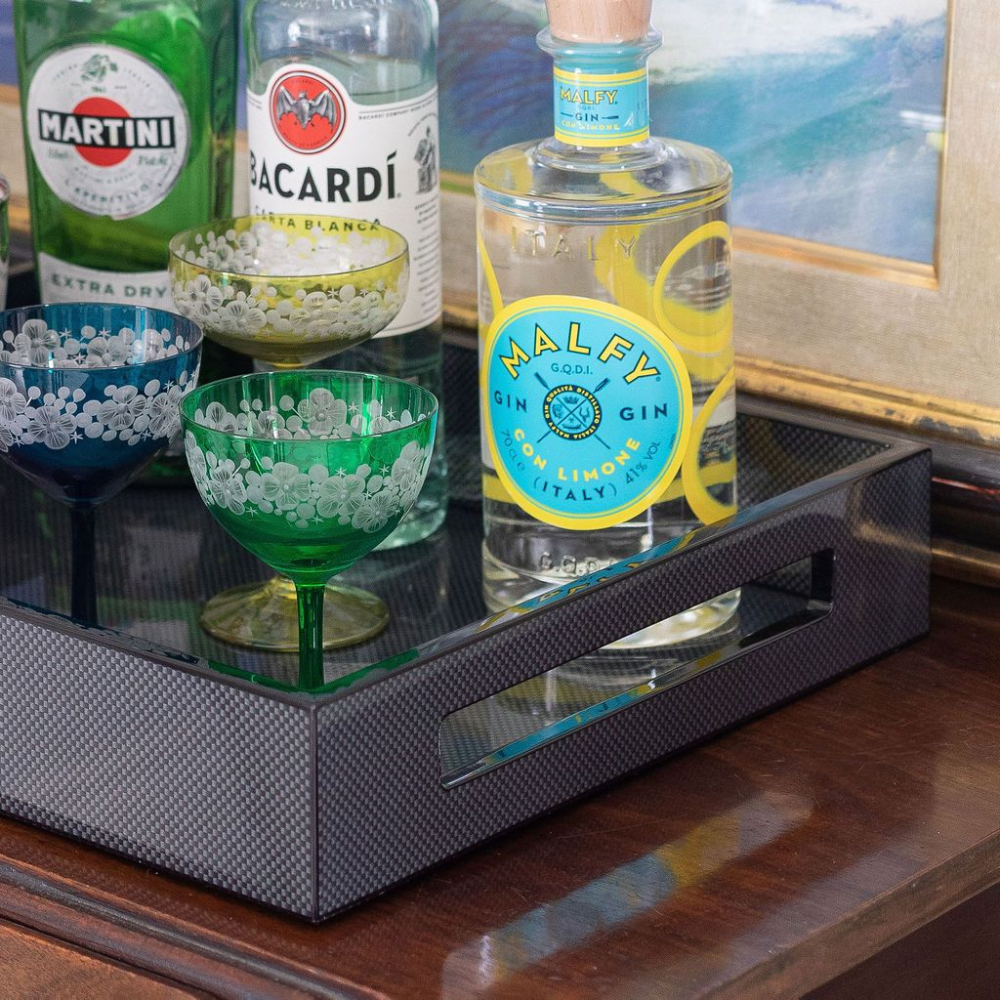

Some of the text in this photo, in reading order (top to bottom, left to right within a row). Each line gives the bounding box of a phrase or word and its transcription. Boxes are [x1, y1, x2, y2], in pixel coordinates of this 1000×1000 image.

[560, 86, 618, 105] MALFY
[40, 112, 172, 147] MARTINI
[575, 112, 599, 122] GIN
[52, 273, 168, 298] EXTRA DRY
[499, 321, 661, 385] MALFY
[551, 363, 593, 375] G.Q.D.I.
[494, 390, 528, 413] GIN
[620, 403, 668, 421] GIN
[514, 428, 640, 482] CON LIMONE
[625, 441, 660, 484] 41% VOL
[533, 476, 617, 501] (ITALY)
